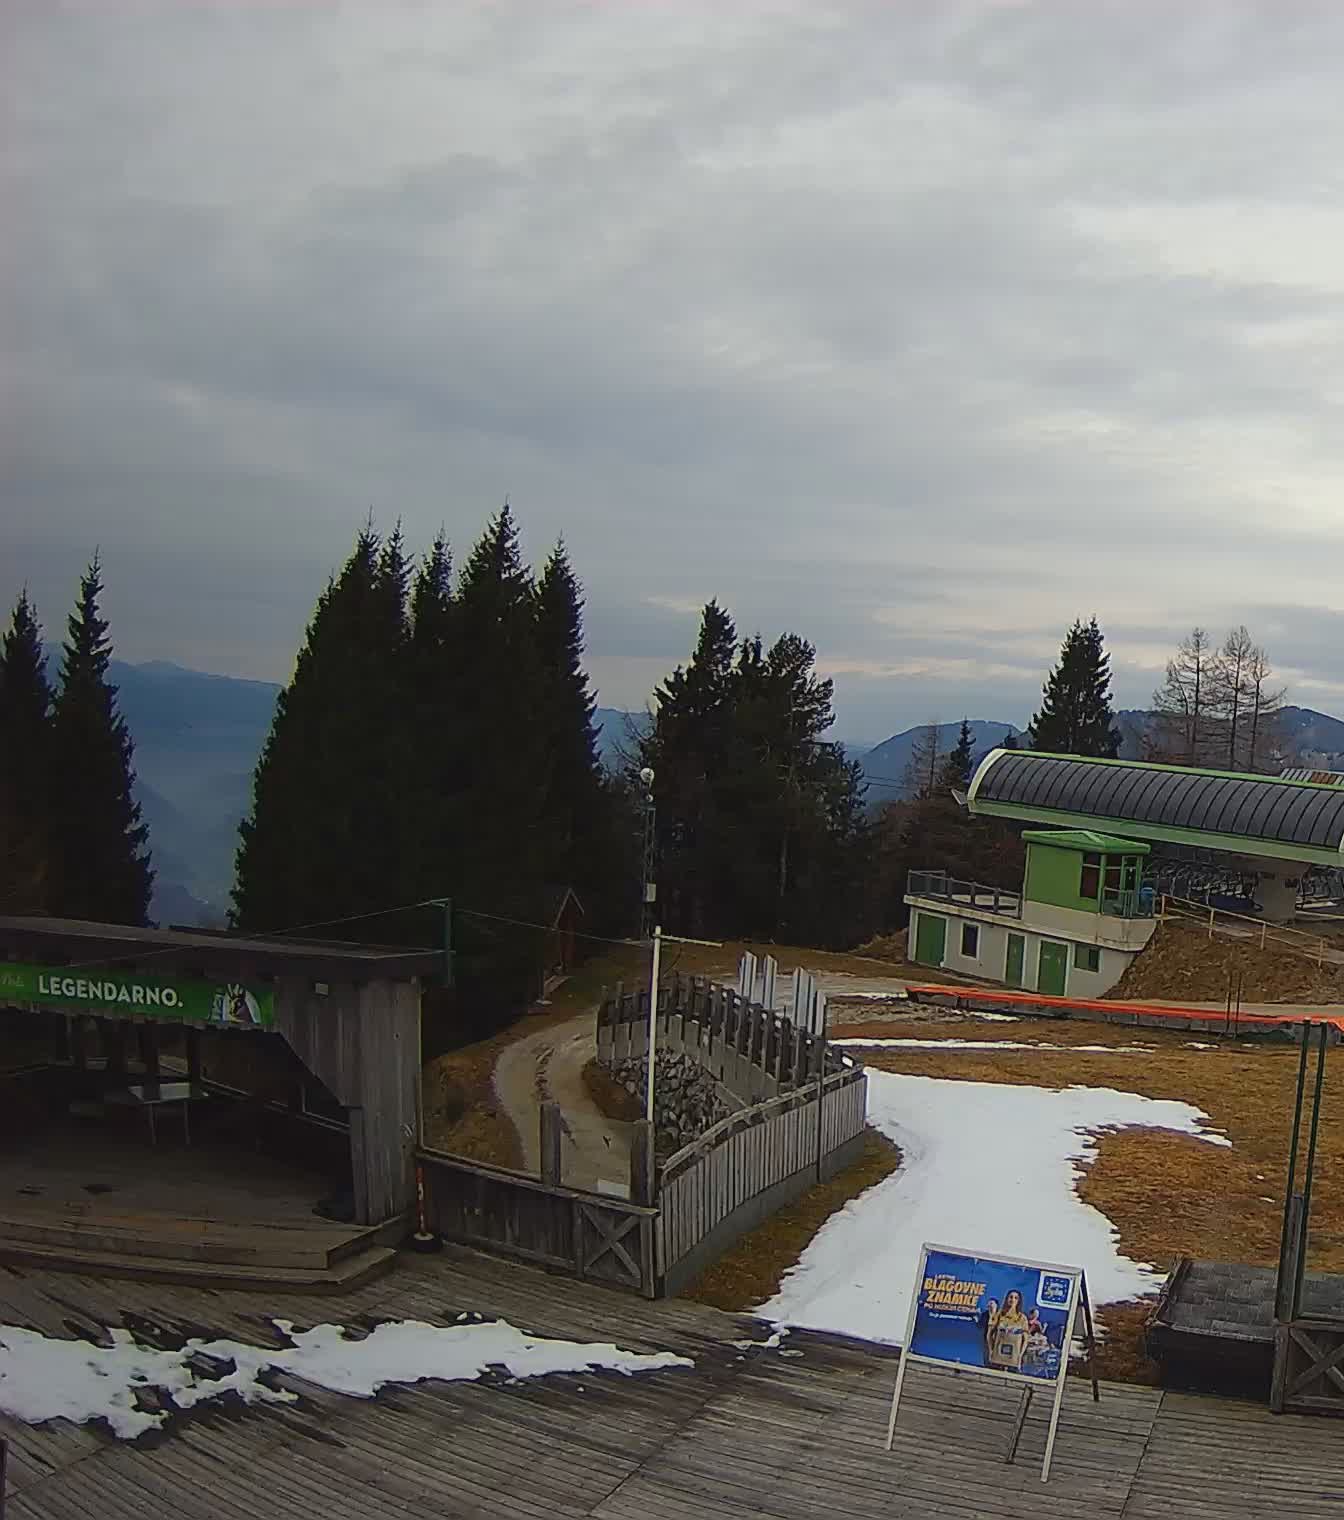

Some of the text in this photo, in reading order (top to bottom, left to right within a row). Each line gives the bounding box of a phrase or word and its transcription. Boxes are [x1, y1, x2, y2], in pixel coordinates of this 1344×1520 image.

[39, 975, 184, 1008] LEGENDARNO.
[924, 1277, 987, 1296] BLAGOVNE
[926, 1290, 979, 1307] ZNAMKE
